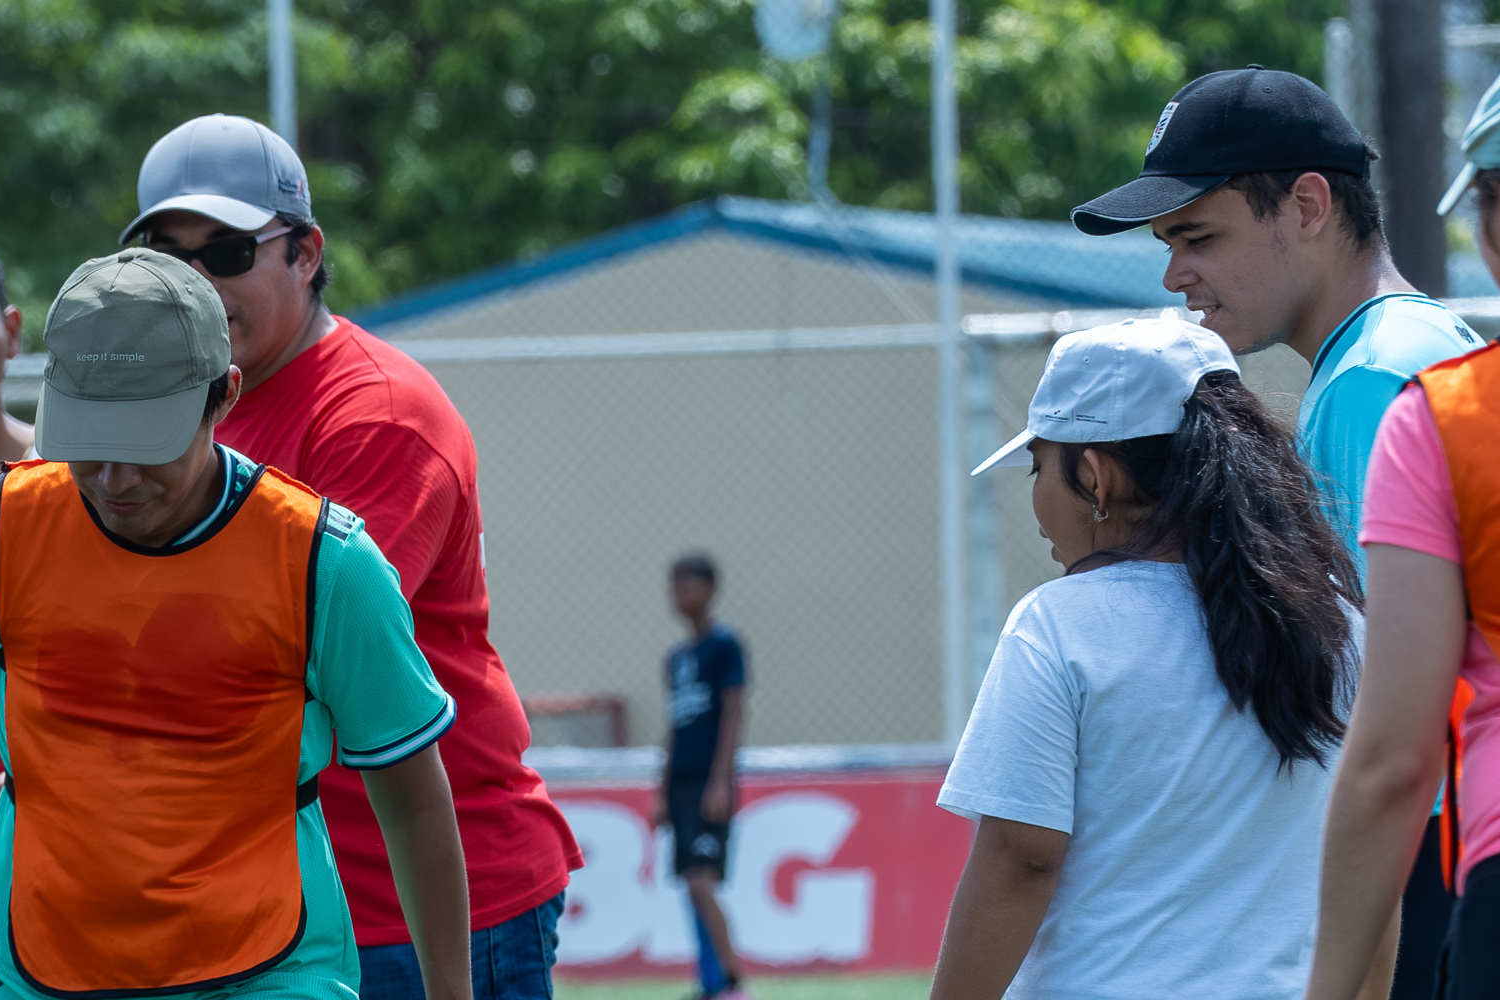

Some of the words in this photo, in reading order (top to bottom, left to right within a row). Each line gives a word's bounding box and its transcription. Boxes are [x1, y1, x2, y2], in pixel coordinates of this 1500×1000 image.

[76, 352, 99, 363] keep
[100, 352, 108, 361] it
[110, 352, 145, 363] simple
